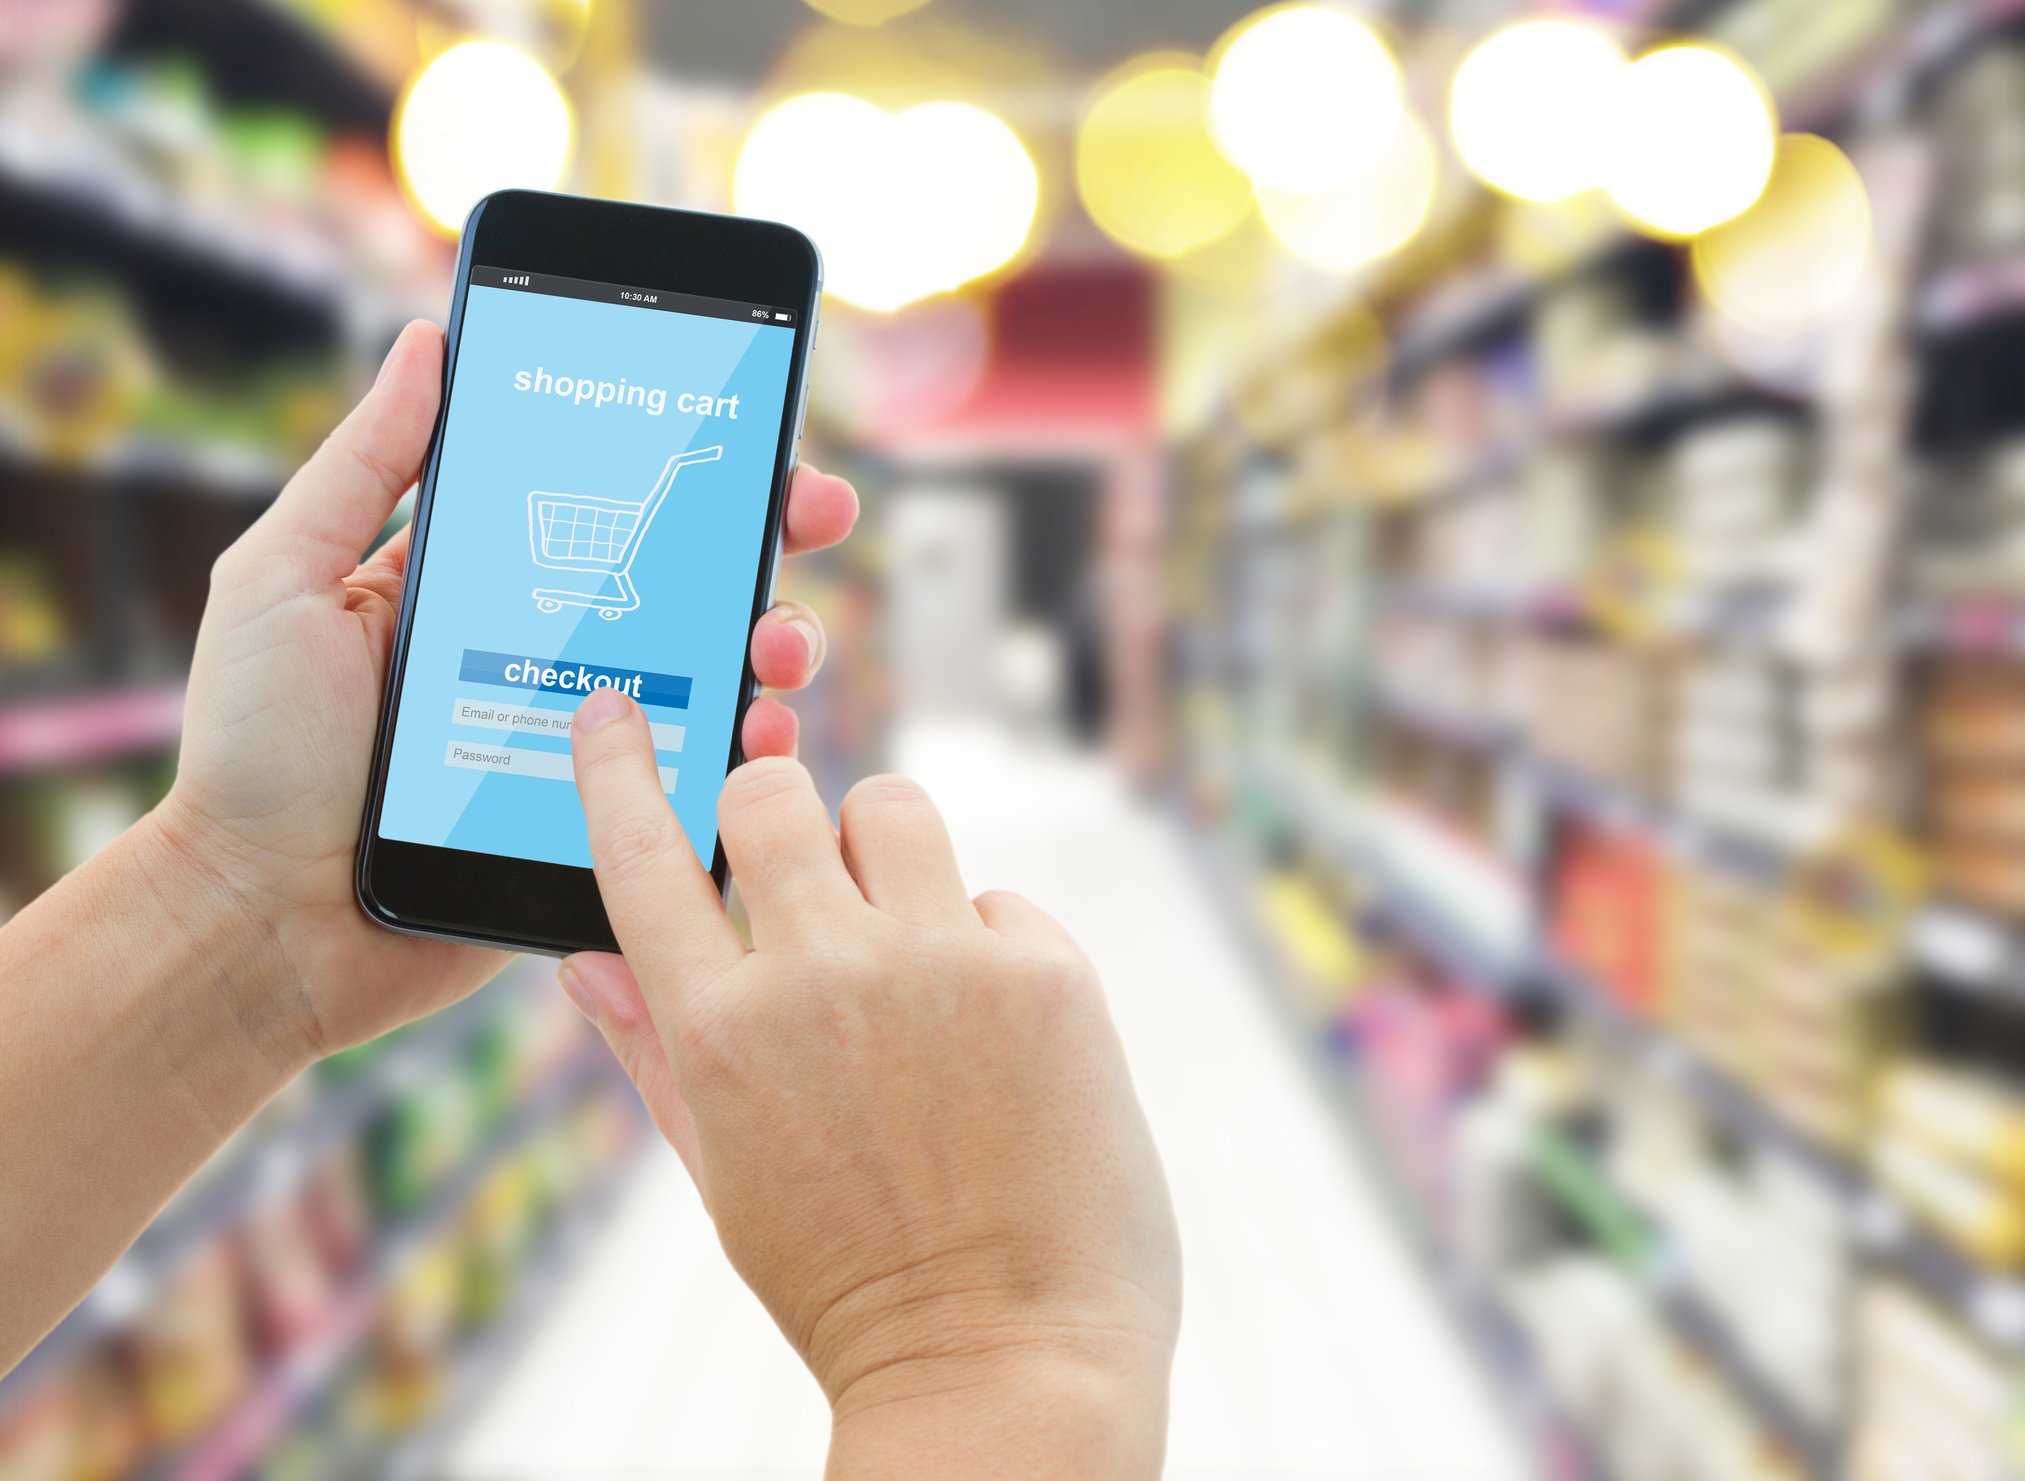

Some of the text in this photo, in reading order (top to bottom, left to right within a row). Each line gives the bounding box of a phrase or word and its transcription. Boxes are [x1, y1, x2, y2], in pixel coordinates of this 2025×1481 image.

[620, 291, 658, 304] 10:30 AM
[751, 309, 770, 319] 86%
[514, 366, 740, 420] shopping cart
[504, 659, 643, 698] checkout
[461, 706, 495, 721] Email
[497, 713, 510, 723] or
[512, 715, 549, 728] phone
[453, 748, 511, 765] Password
